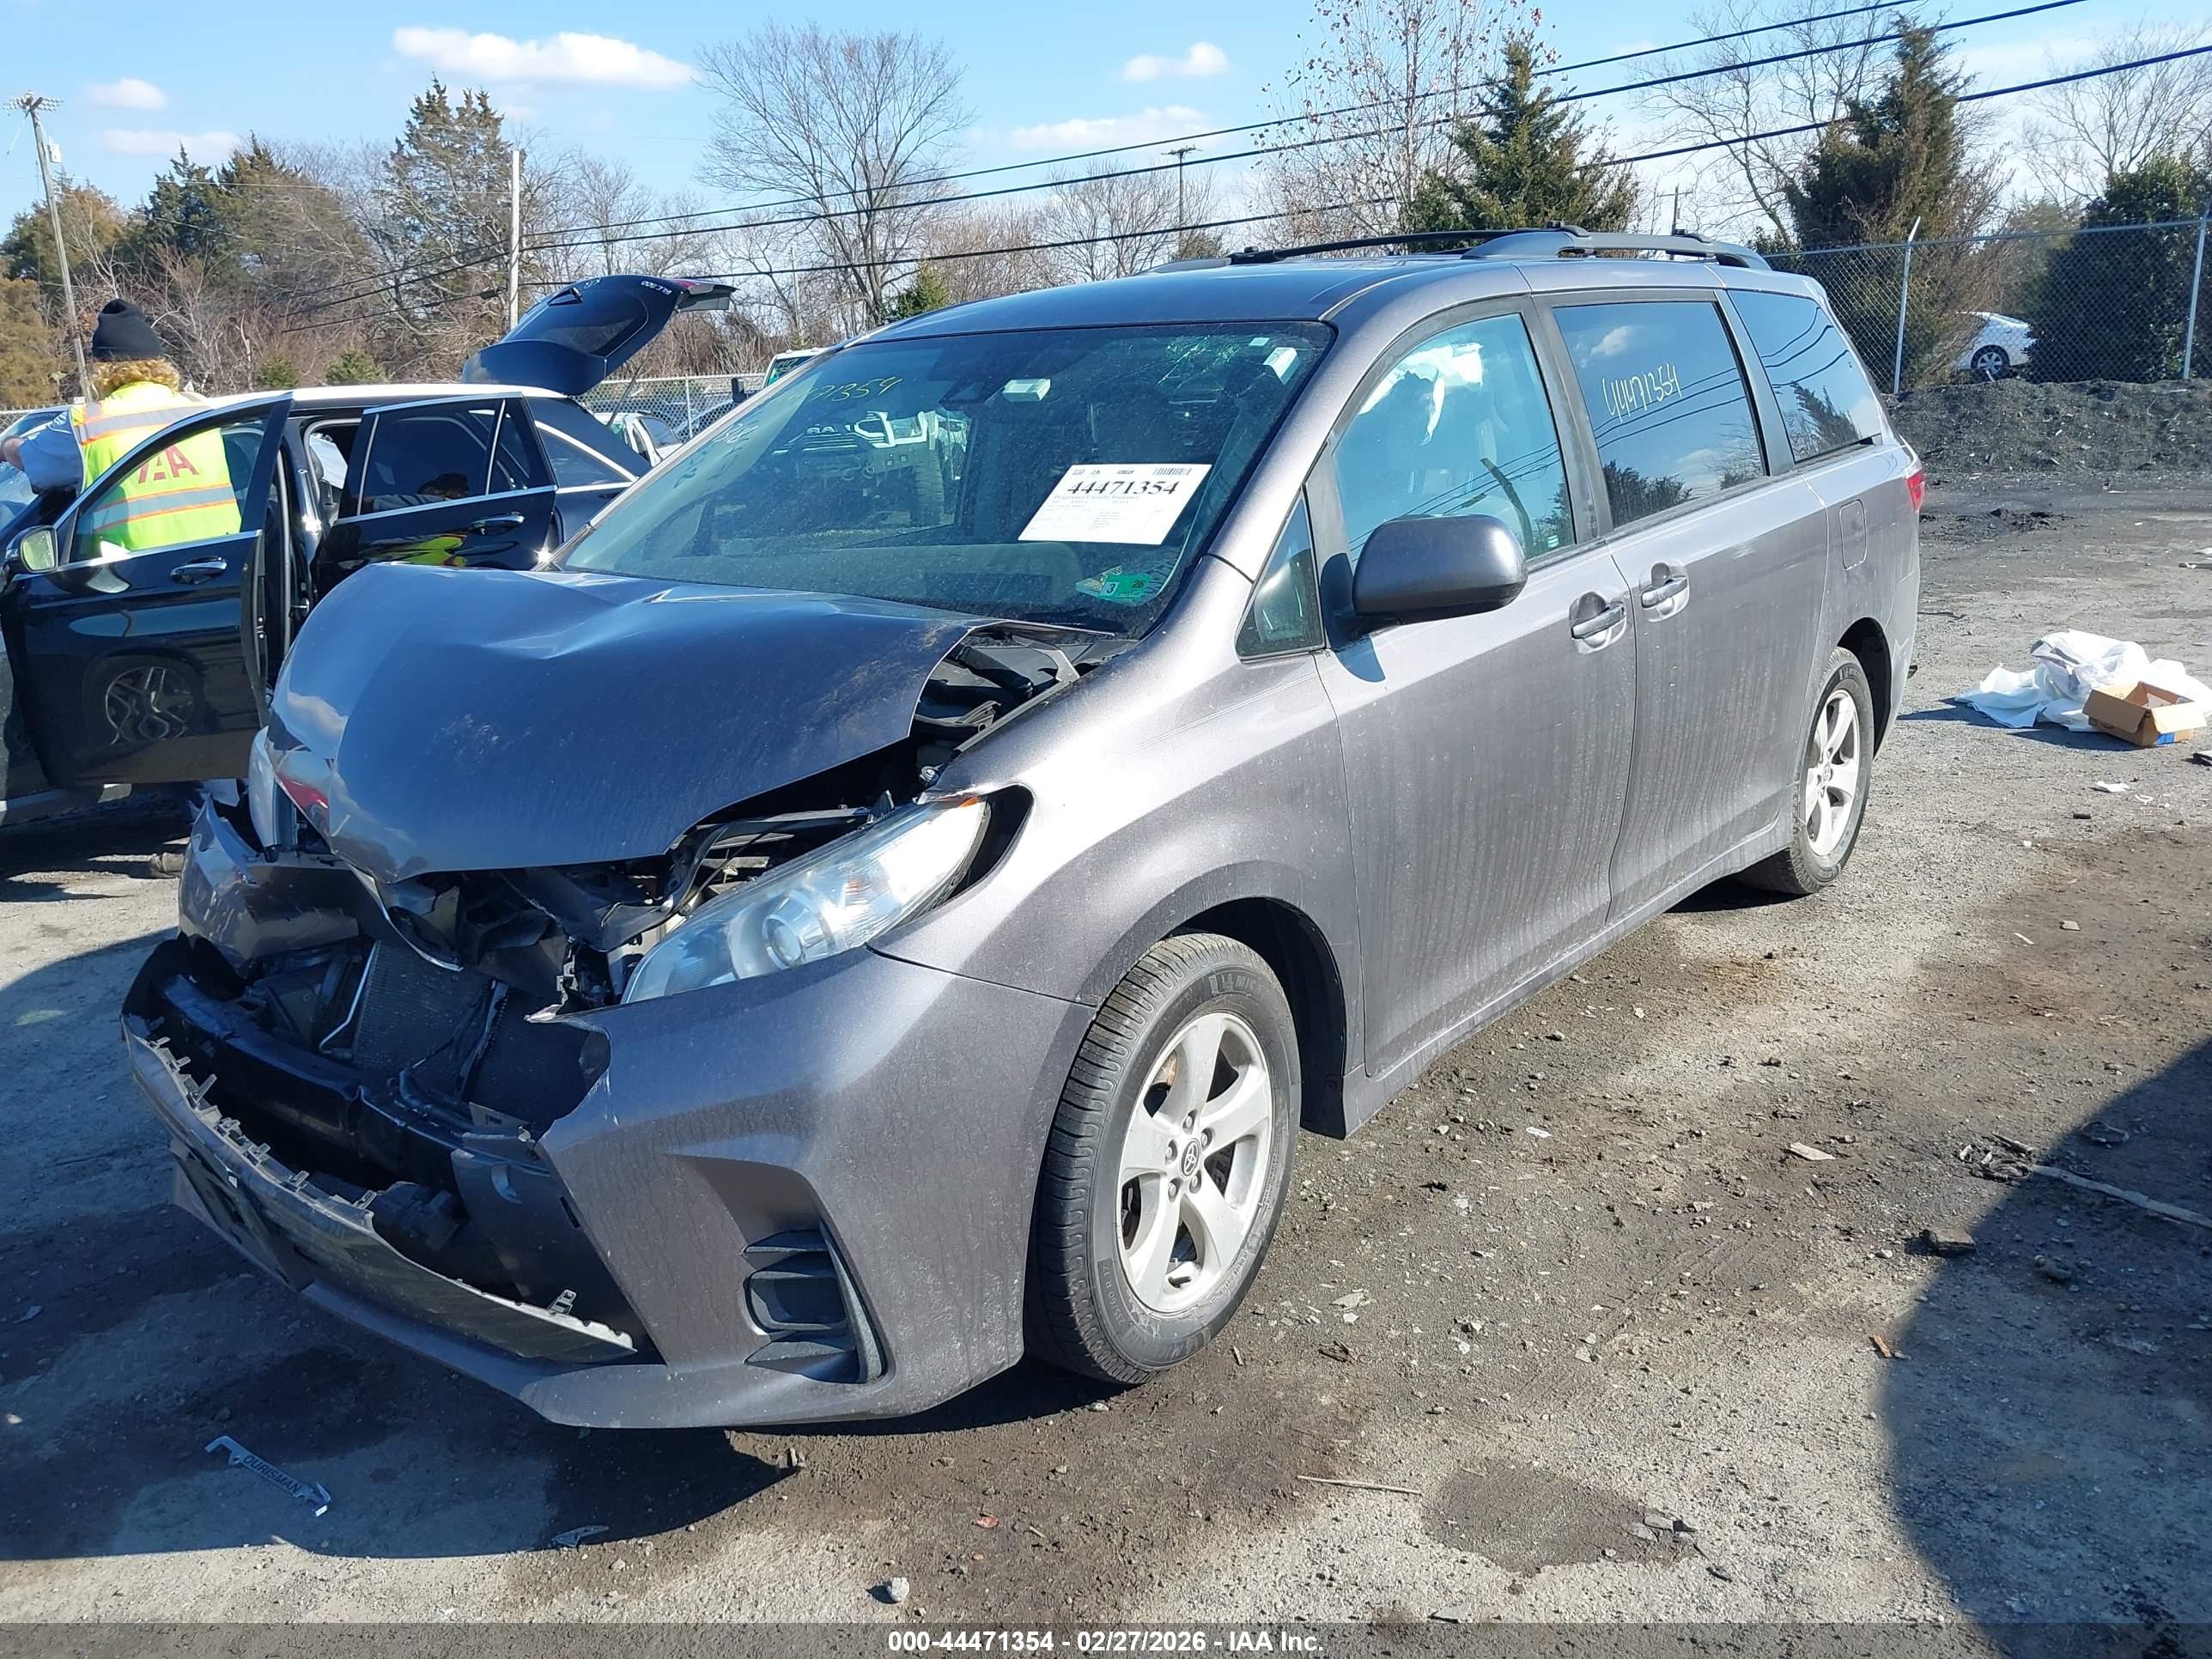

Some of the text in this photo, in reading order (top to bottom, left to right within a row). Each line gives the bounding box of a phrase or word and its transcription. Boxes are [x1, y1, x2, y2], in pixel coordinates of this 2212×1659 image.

[1067, 481, 1178, 495] 44471354
[1106, 583, 1115, 593] 3
[1132, 580, 1146, 588] 26
[242, 1455, 303, 1493] OURISMAN
